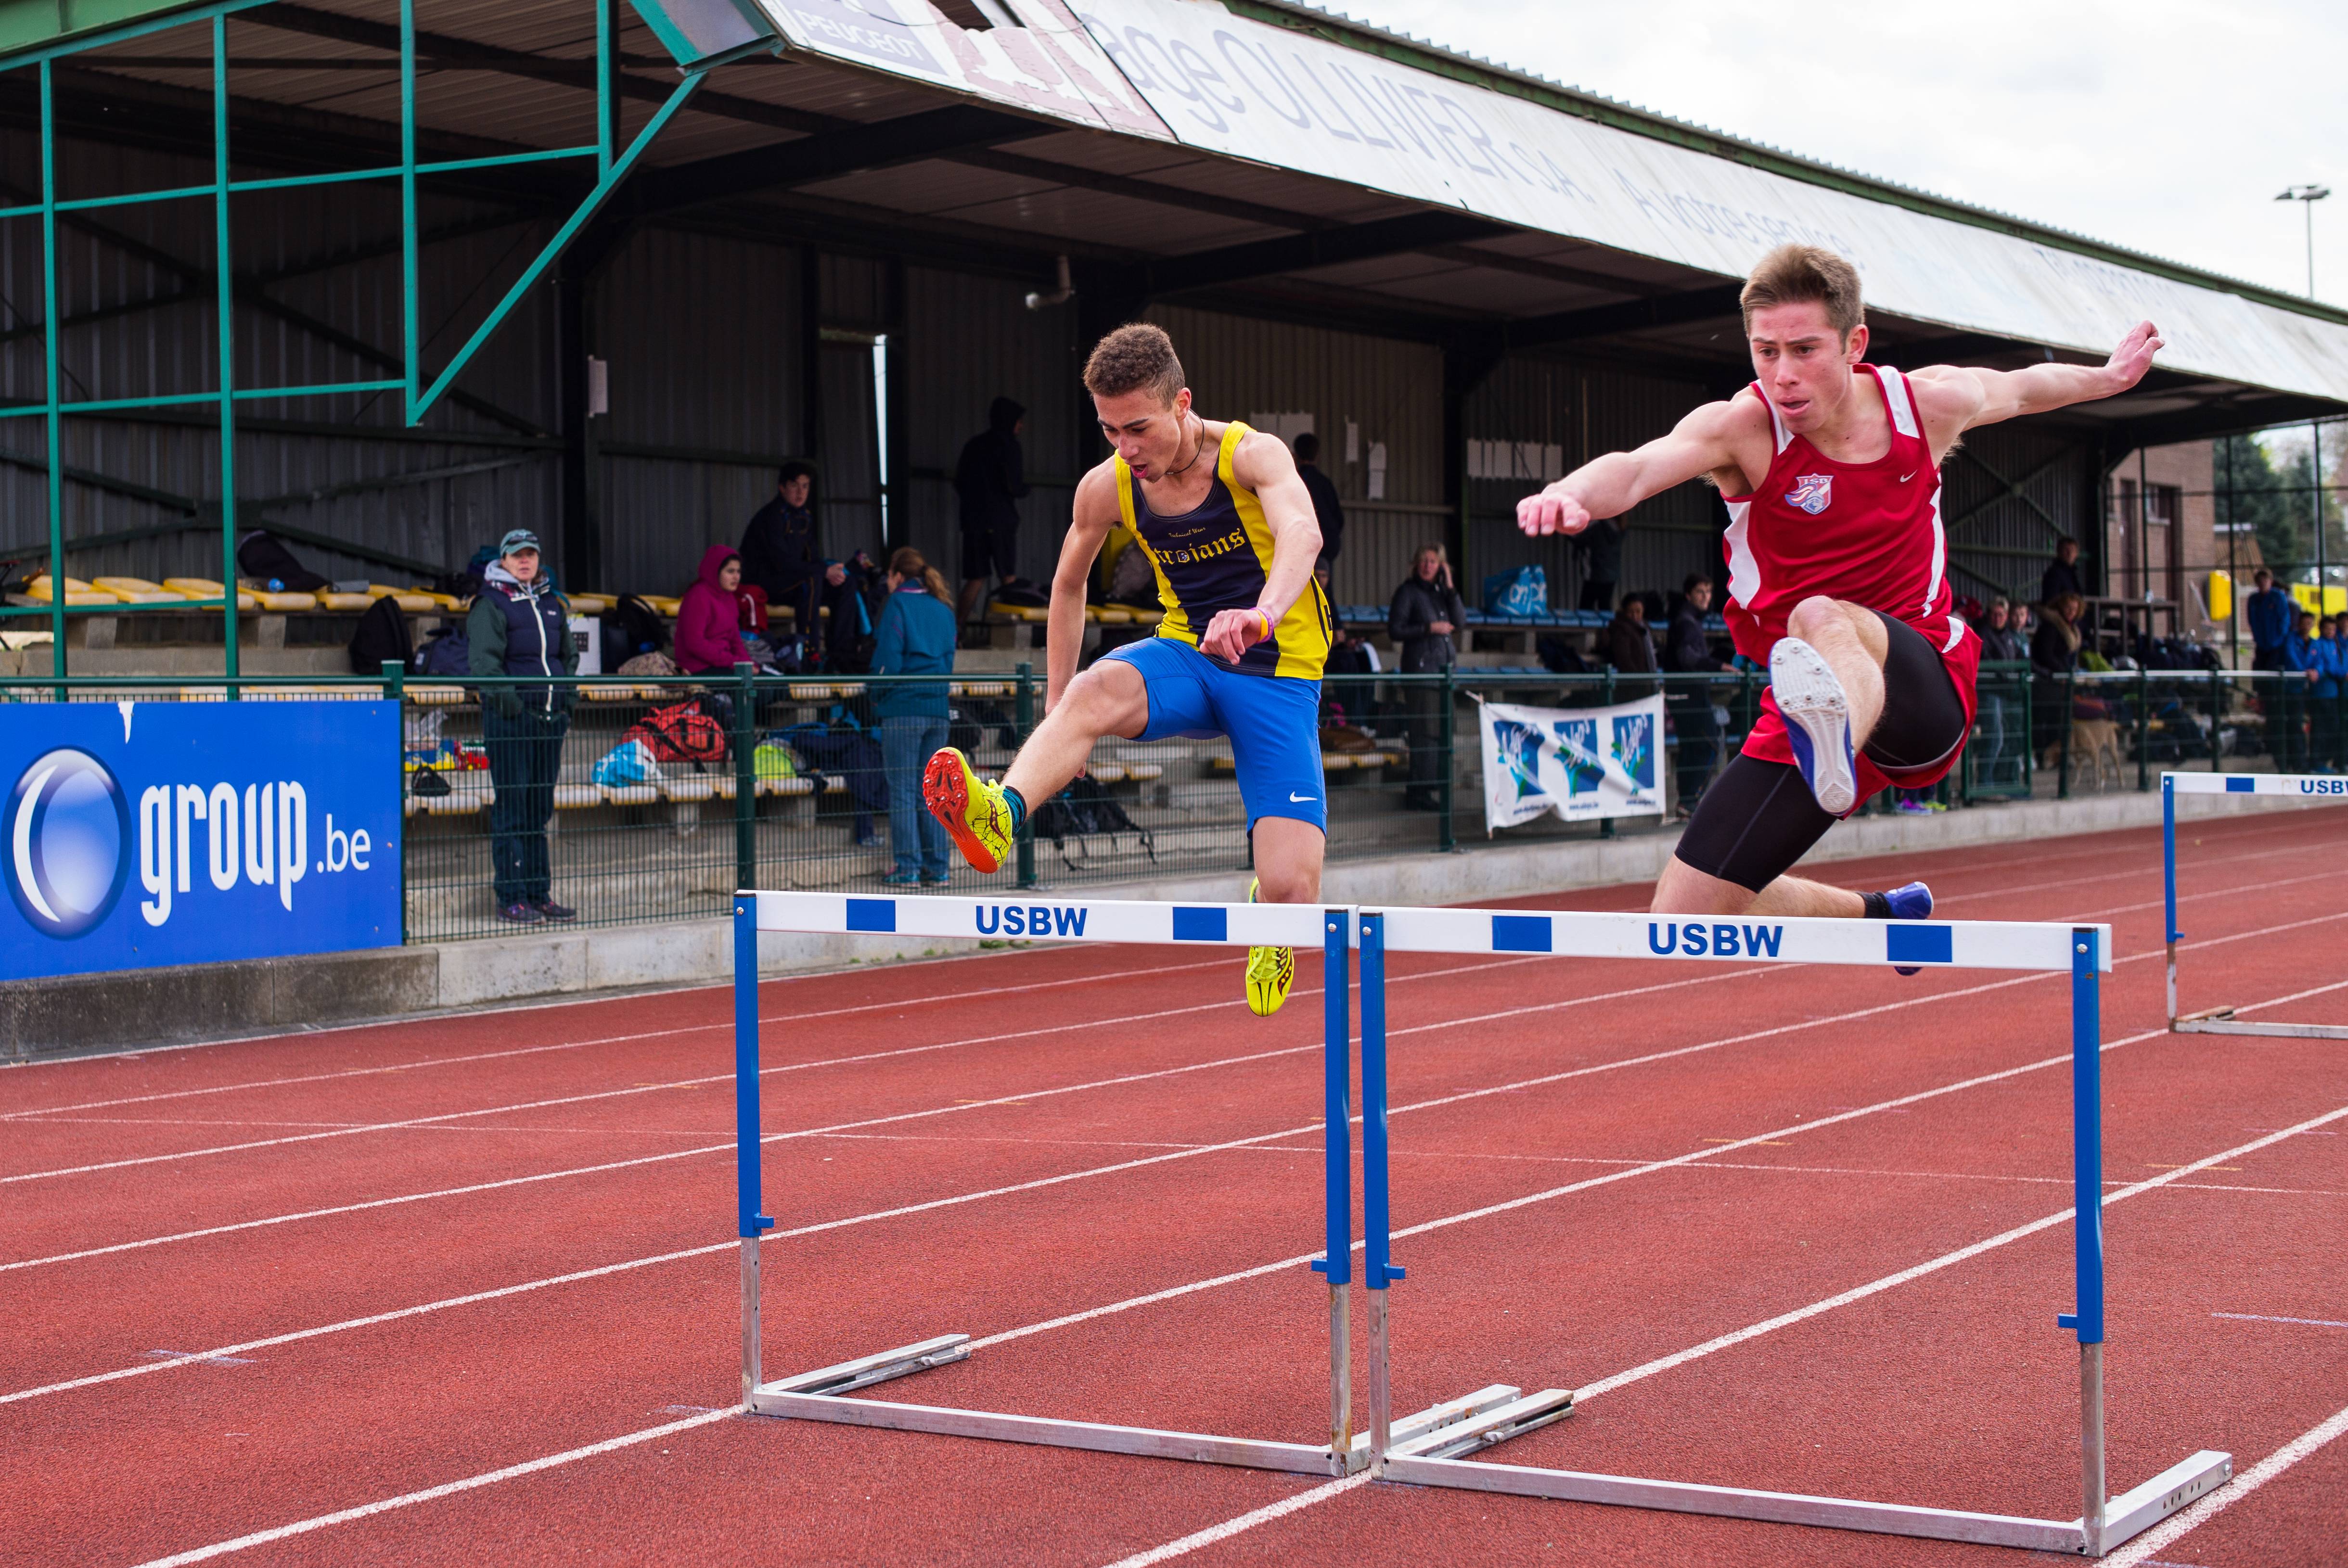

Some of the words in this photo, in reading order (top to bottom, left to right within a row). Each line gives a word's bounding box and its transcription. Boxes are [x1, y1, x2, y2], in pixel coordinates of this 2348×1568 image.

[794, 9, 924, 61] PEUGEOT
[1213, 30, 1535, 186] OLLIVIER
[1154, 528, 1245, 565] trojans
[141, 781, 307, 926] group
[317, 814, 371, 873] .be
[975, 905, 1088, 937] USBW
[1649, 923, 1783, 957] USBW
